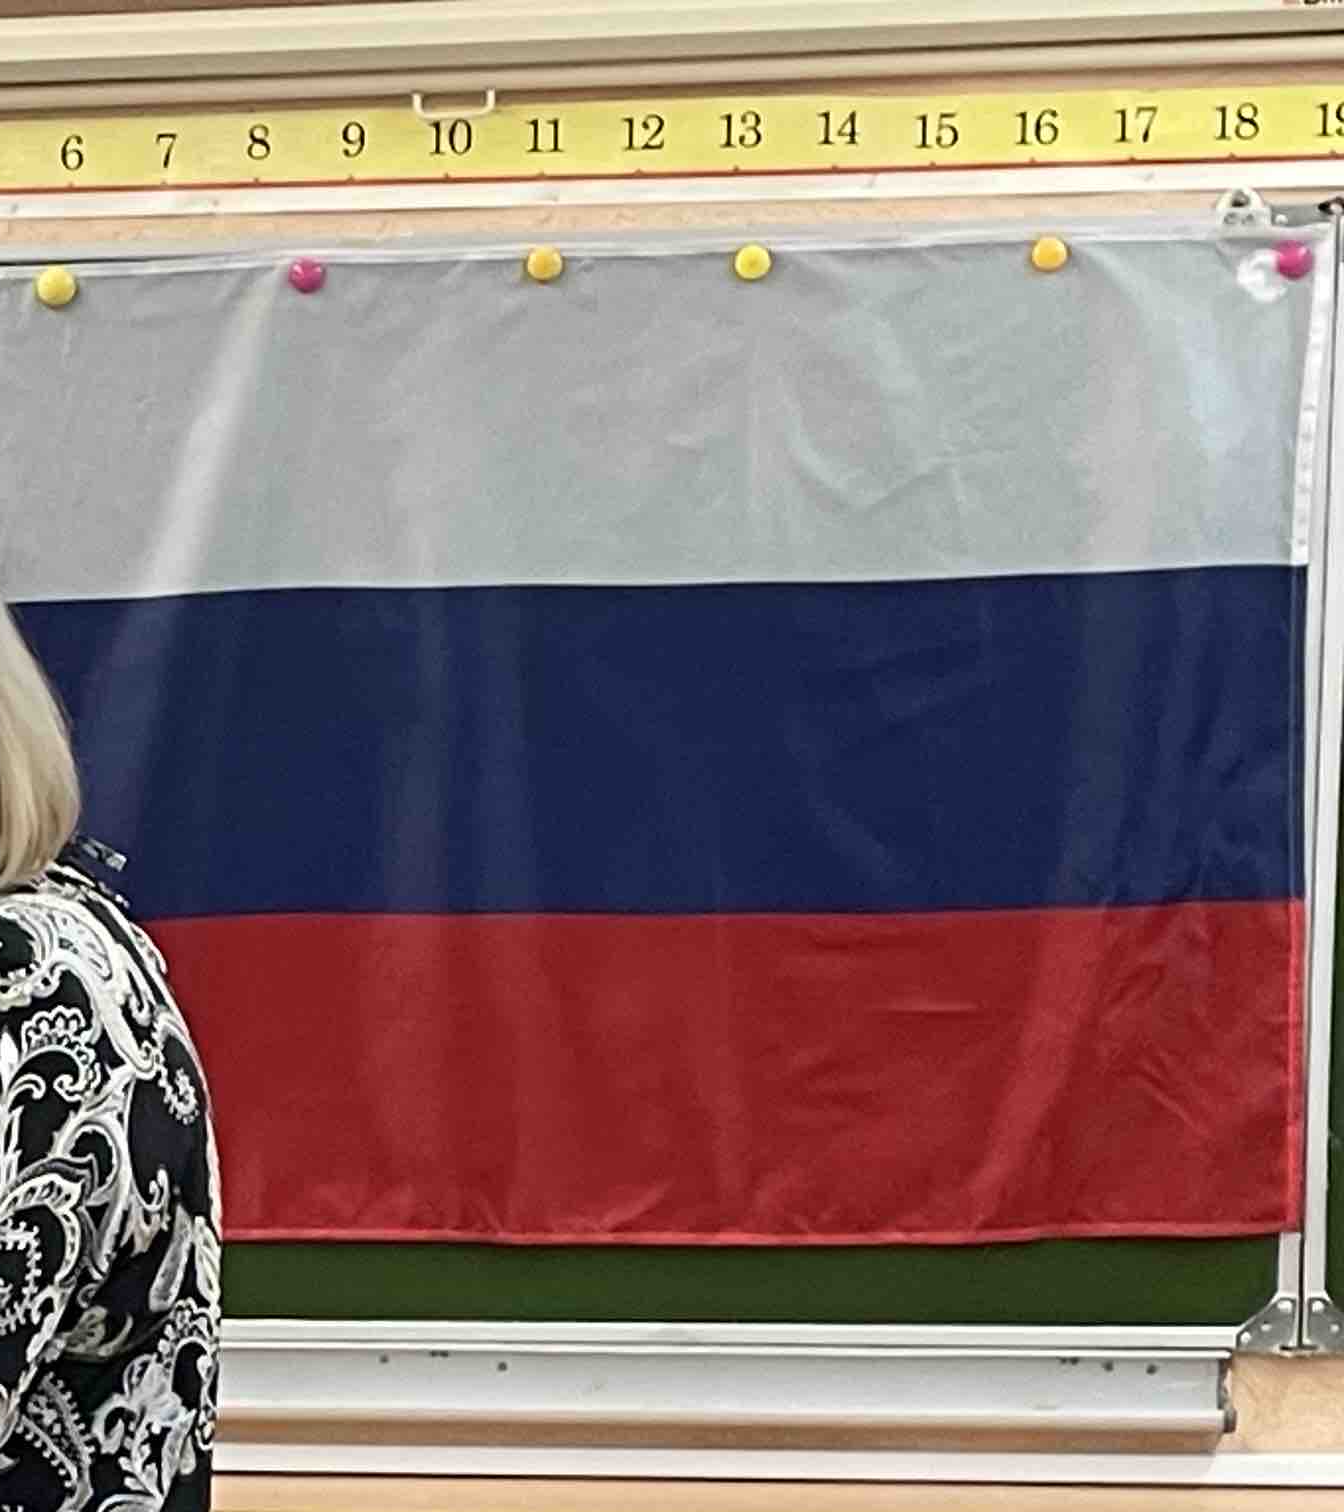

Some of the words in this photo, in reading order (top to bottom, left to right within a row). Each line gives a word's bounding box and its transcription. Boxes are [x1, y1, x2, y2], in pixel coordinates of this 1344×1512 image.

[61, 136, 84, 170] 6
[156, 133, 177, 169] 7
[247, 125, 271, 159] 8
[342, 122, 365, 157] 9
[429, 118, 472, 155] 10
[526, 118, 563, 153] 11
[623, 115, 665, 151] 12
[721, 111, 762, 148] 13
[818, 111, 859, 145] 14
[916, 113, 959, 149] 15
[1015, 109, 1060, 145] 16
[1115, 106, 1157, 143] 17
[1214, 103, 1260, 140] 18
